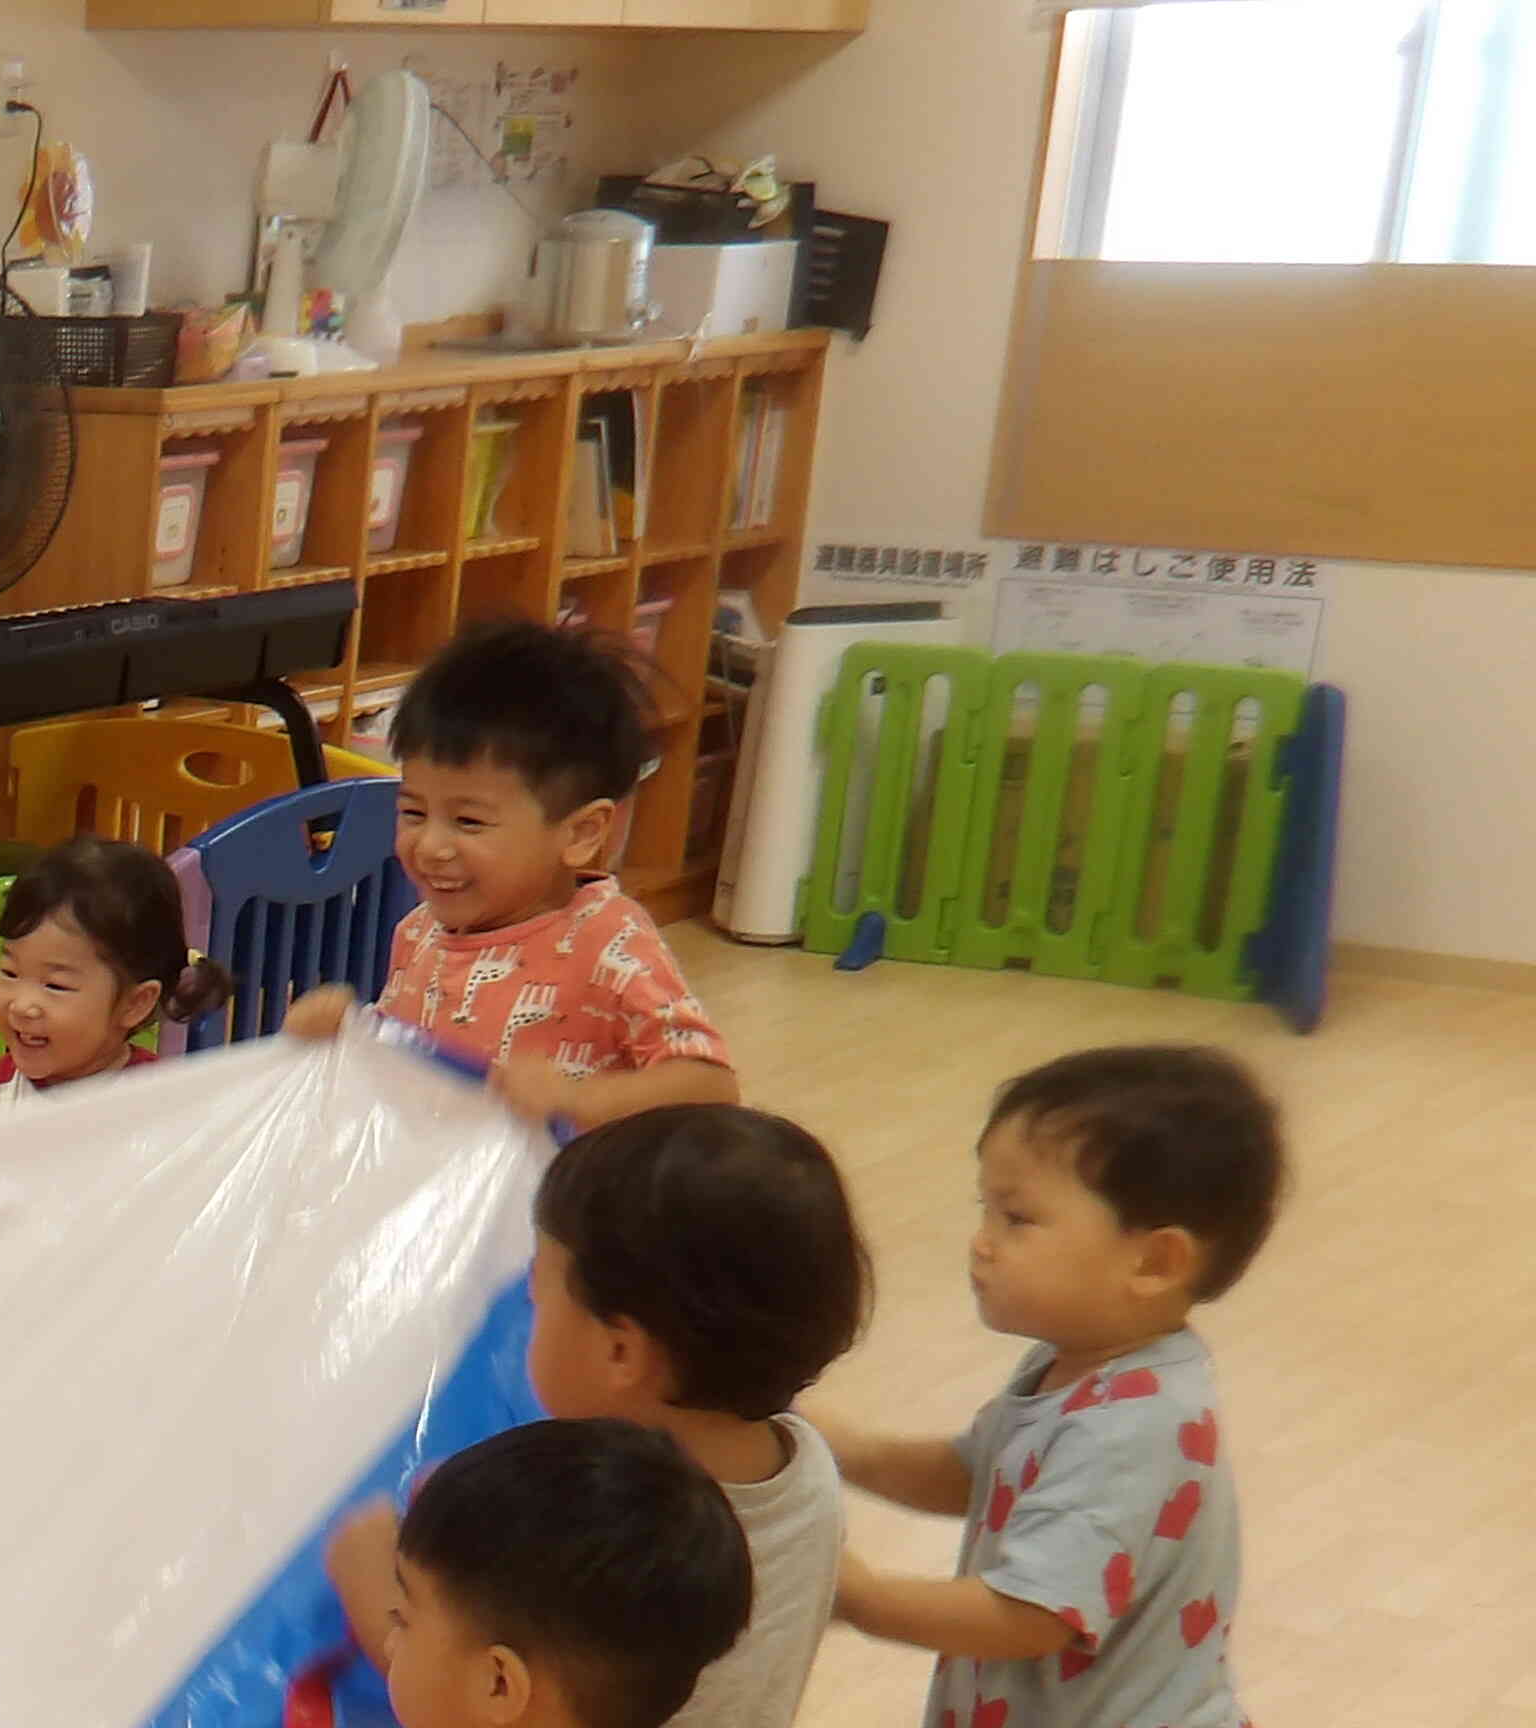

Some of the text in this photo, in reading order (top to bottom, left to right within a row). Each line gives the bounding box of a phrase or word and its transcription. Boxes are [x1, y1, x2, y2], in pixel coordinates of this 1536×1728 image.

[1013, 545, 1317, 588] 避難はしご使用法
